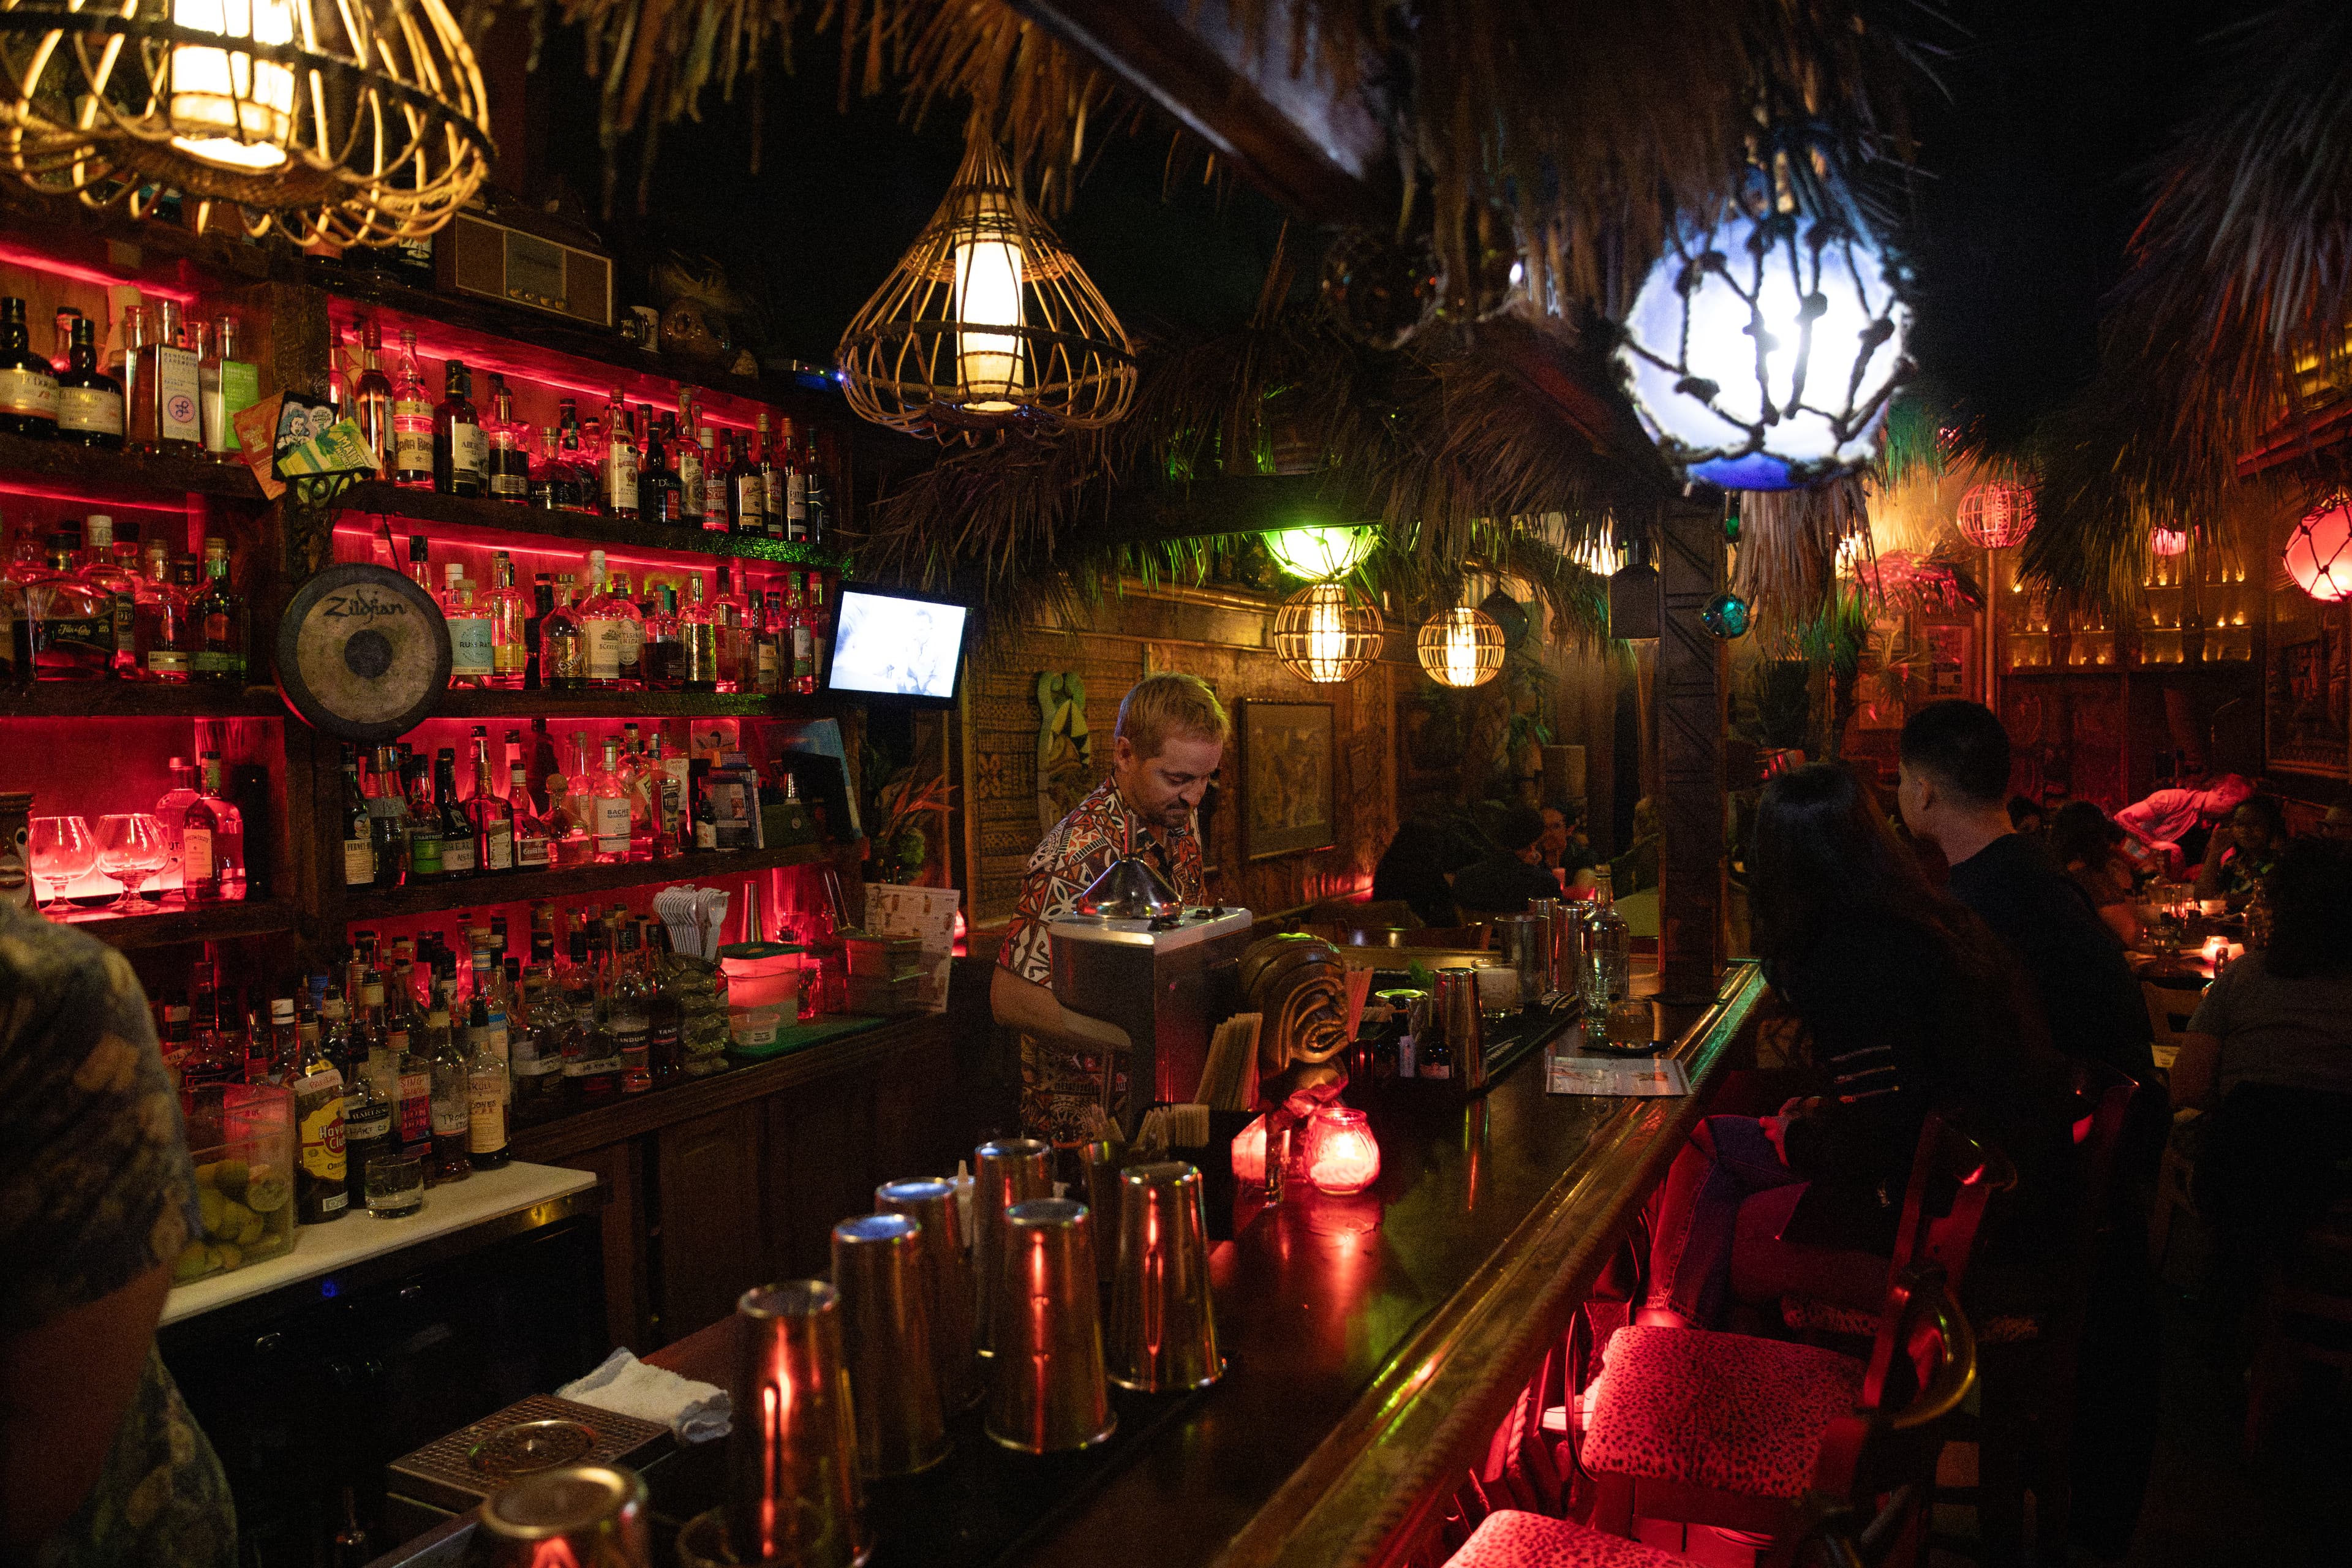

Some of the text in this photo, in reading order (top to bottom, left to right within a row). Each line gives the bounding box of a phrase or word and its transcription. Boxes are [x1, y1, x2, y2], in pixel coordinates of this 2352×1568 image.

[670, 492, 679, 503] 12
[324, 589, 407, 625] Zildjian
[318, 1125, 344, 1139] Hava
[330, 1135, 345, 1150] Clu
